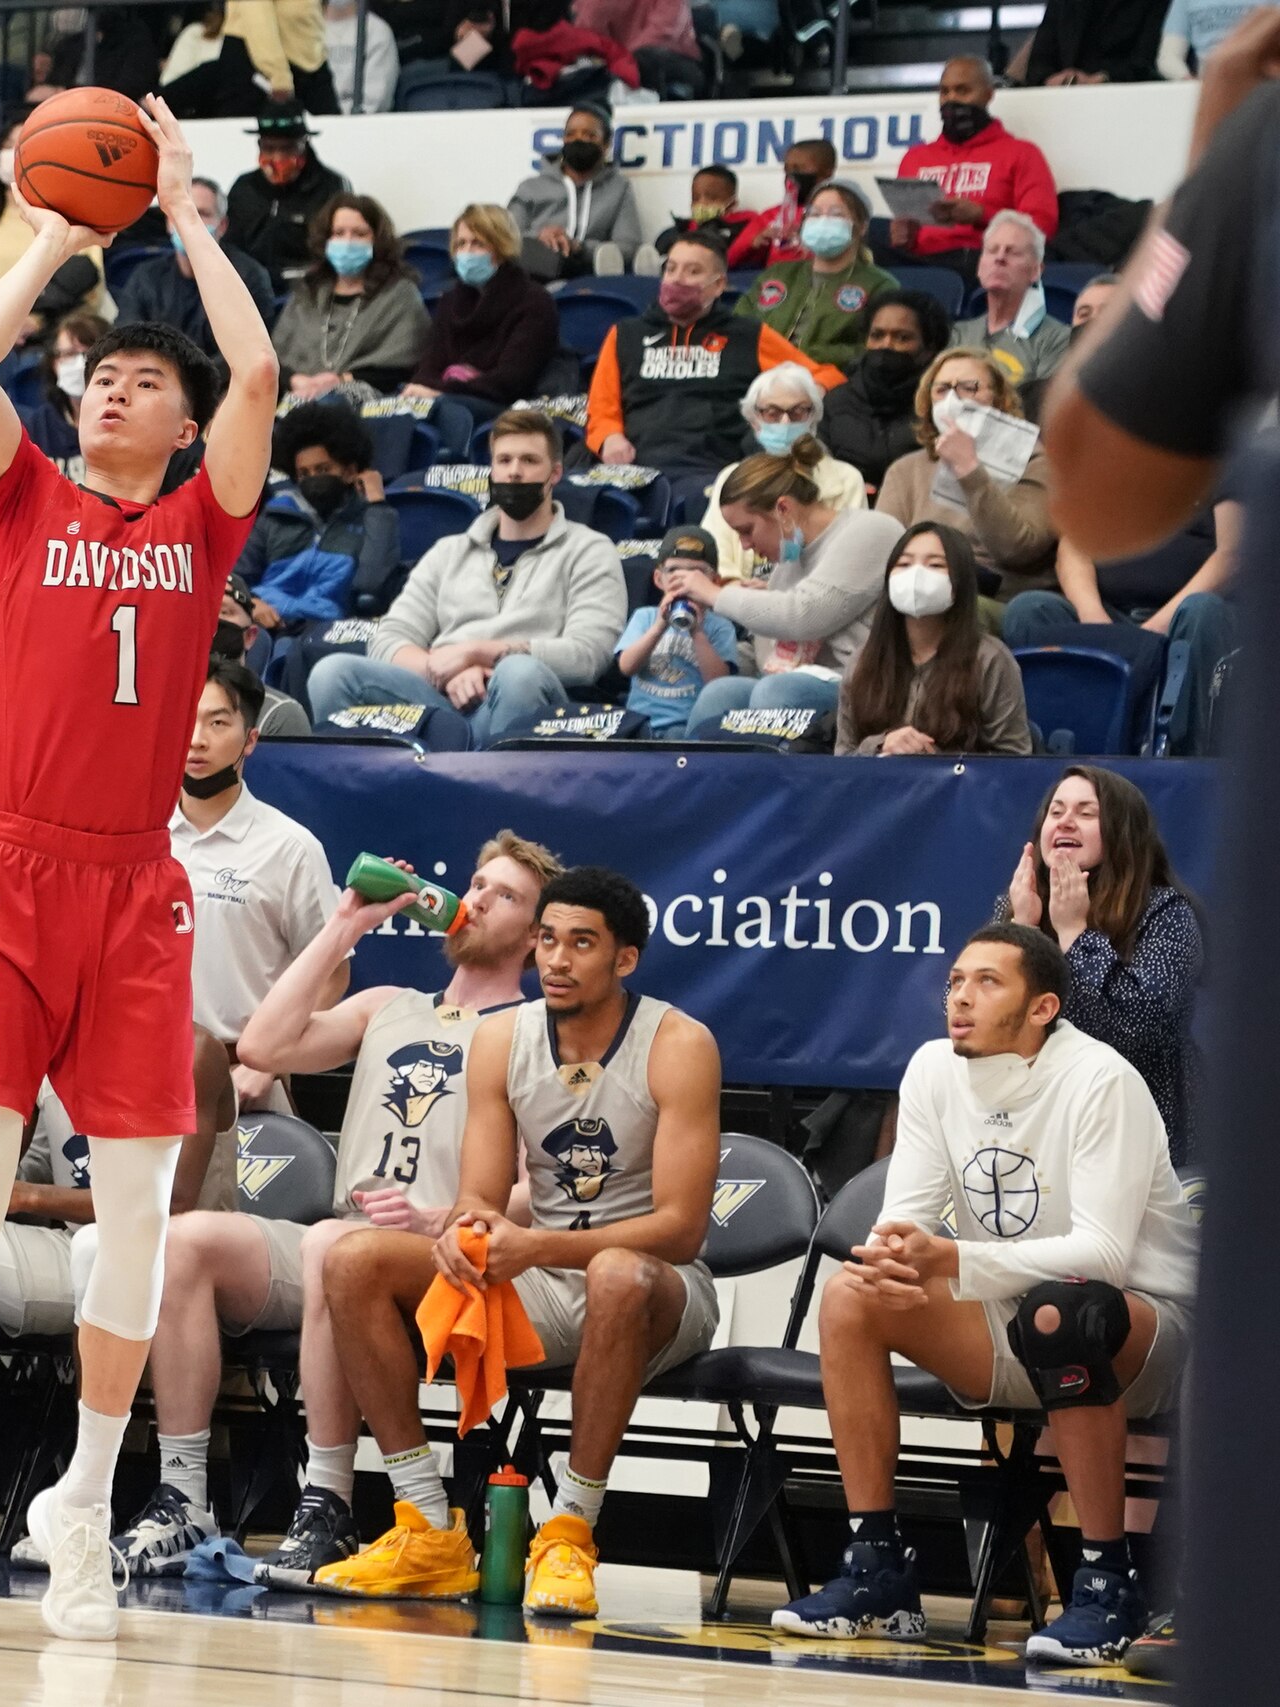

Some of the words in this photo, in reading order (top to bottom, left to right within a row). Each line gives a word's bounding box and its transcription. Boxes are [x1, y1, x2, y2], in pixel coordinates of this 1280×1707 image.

[532, 121, 795, 168] SCTION
[820, 115, 926, 160] 104
[640, 360, 720, 379] ORIOLES
[41, 538, 193, 594] DAVIDSON
[110, 604, 140, 707] 1
[637, 678, 696, 698] NIVERSITY
[567, 713, 608, 733] FINALLY
[795, 708, 817, 722] LET
[207, 892, 246, 905] BASKETBALL
[984, 1118, 1013, 1128] adidas
[373, 1131, 421, 1185] 13
